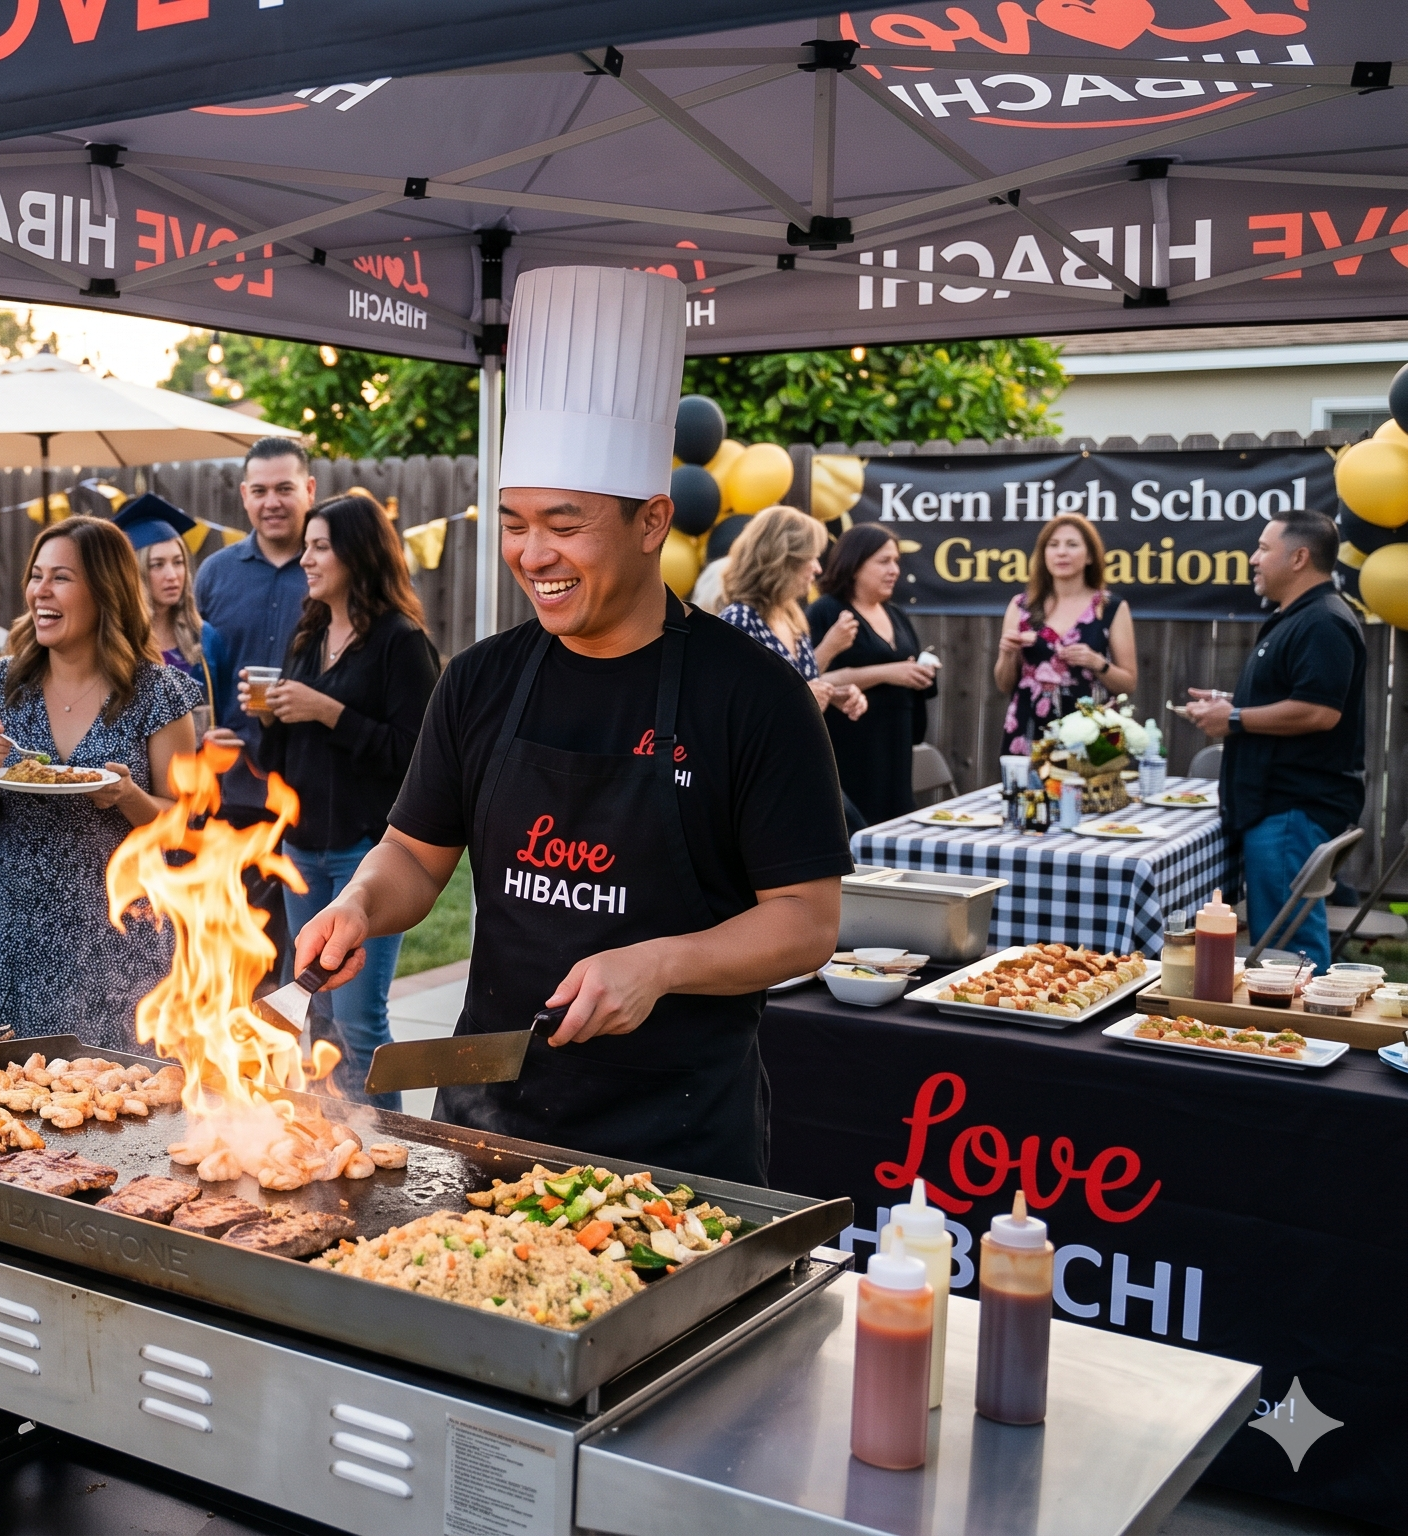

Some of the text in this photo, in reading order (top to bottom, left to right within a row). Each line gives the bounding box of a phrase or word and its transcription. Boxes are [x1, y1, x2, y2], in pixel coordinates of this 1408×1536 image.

[879, 477, 1307, 522] Kern High School
[934, 536, 1251, 585] Graation
[516, 814, 615, 873] Love
[504, 867, 626, 914] HIBACHI
[874, 1072, 1161, 1223] Love
[839, 1206, 1203, 1342] HBCHI
